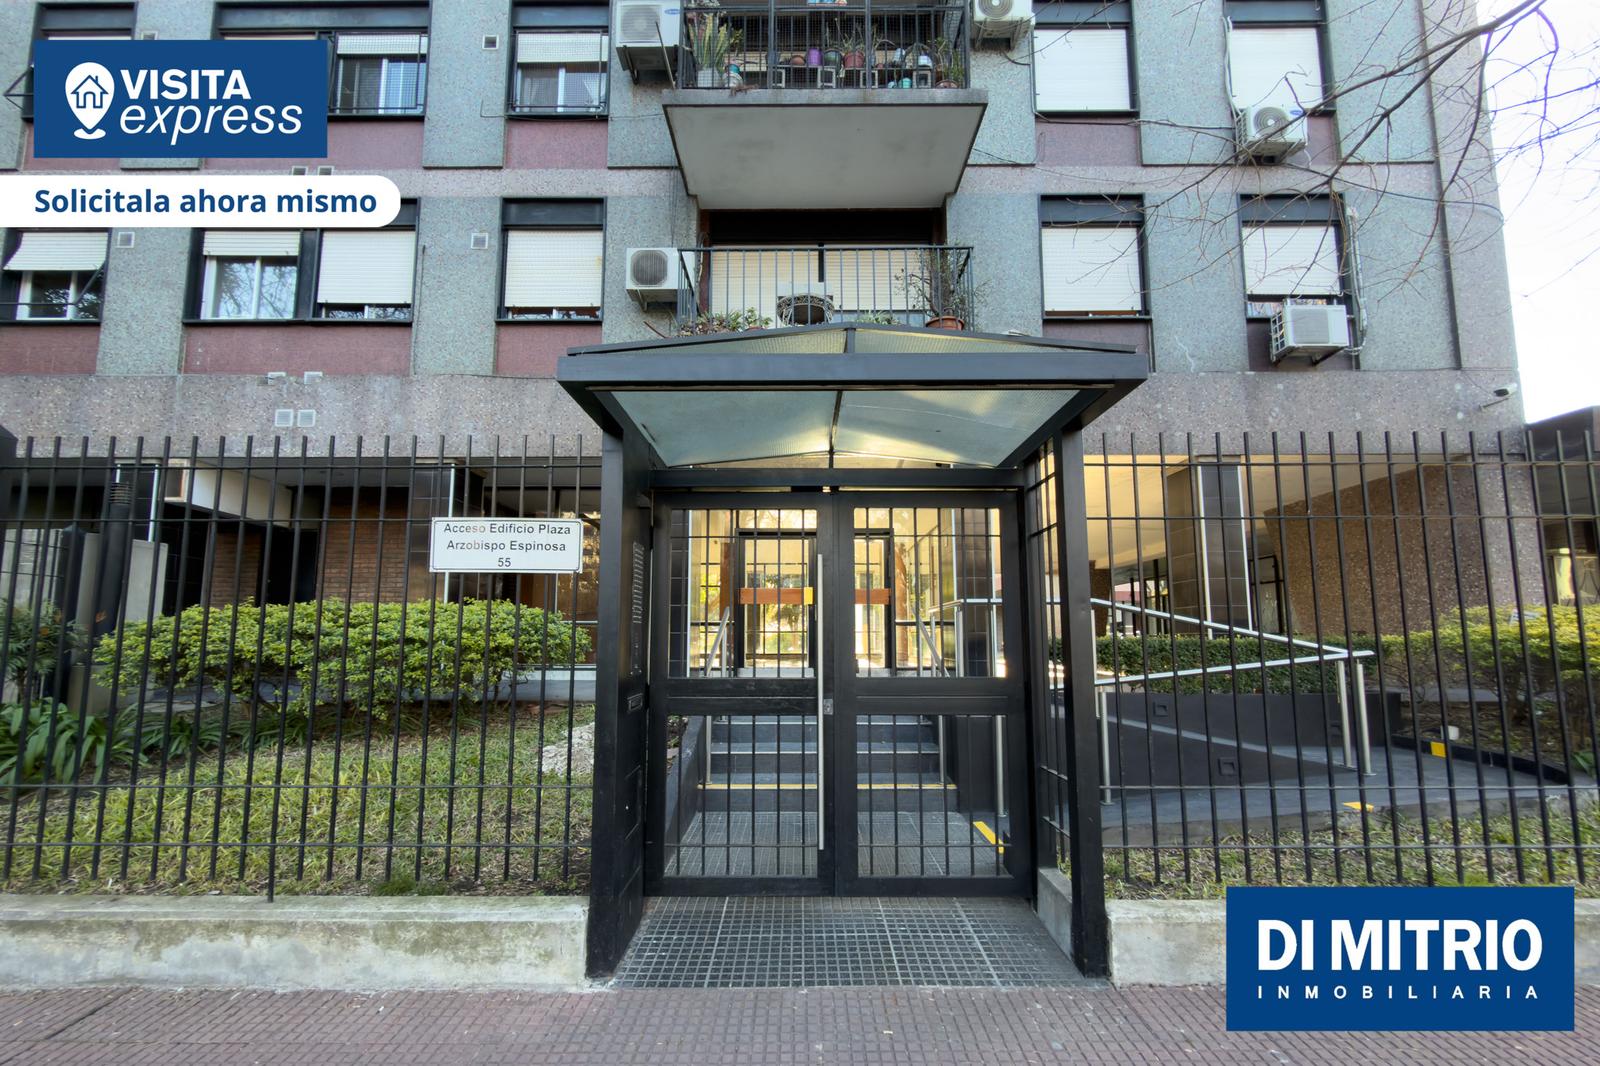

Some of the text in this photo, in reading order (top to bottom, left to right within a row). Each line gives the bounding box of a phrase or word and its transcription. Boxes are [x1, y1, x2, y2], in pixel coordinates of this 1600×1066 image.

[444, 523, 571, 535] Acceso Edificio Plaza
[446, 540, 566, 552] Arzobispo Espinosa
[497, 557, 511, 567] 55
